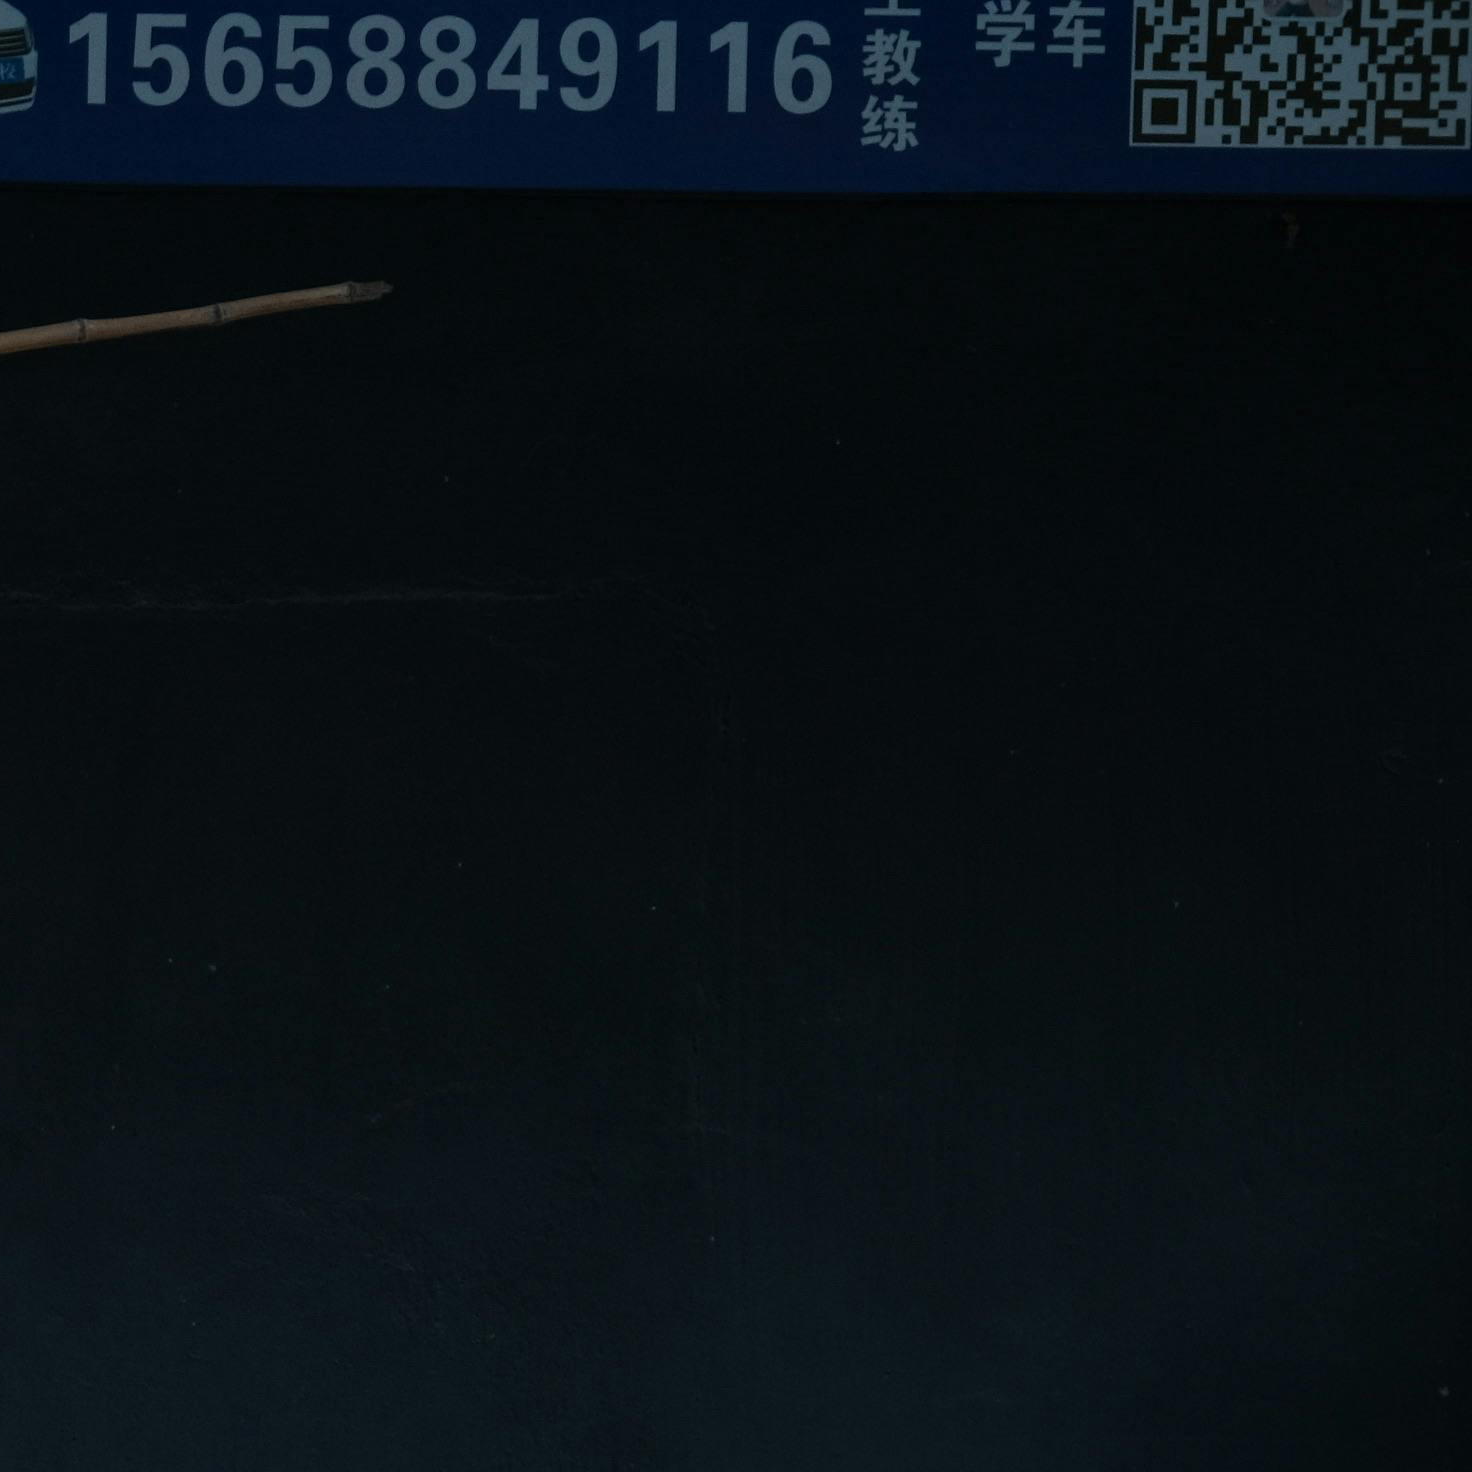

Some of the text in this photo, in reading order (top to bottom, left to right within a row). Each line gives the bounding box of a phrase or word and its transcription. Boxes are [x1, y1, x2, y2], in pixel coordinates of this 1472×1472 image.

[67, 11, 834, 115] 15658849116
[860, 0, 922, 152] 教练
[975, 0, 1107, 69] 学车
